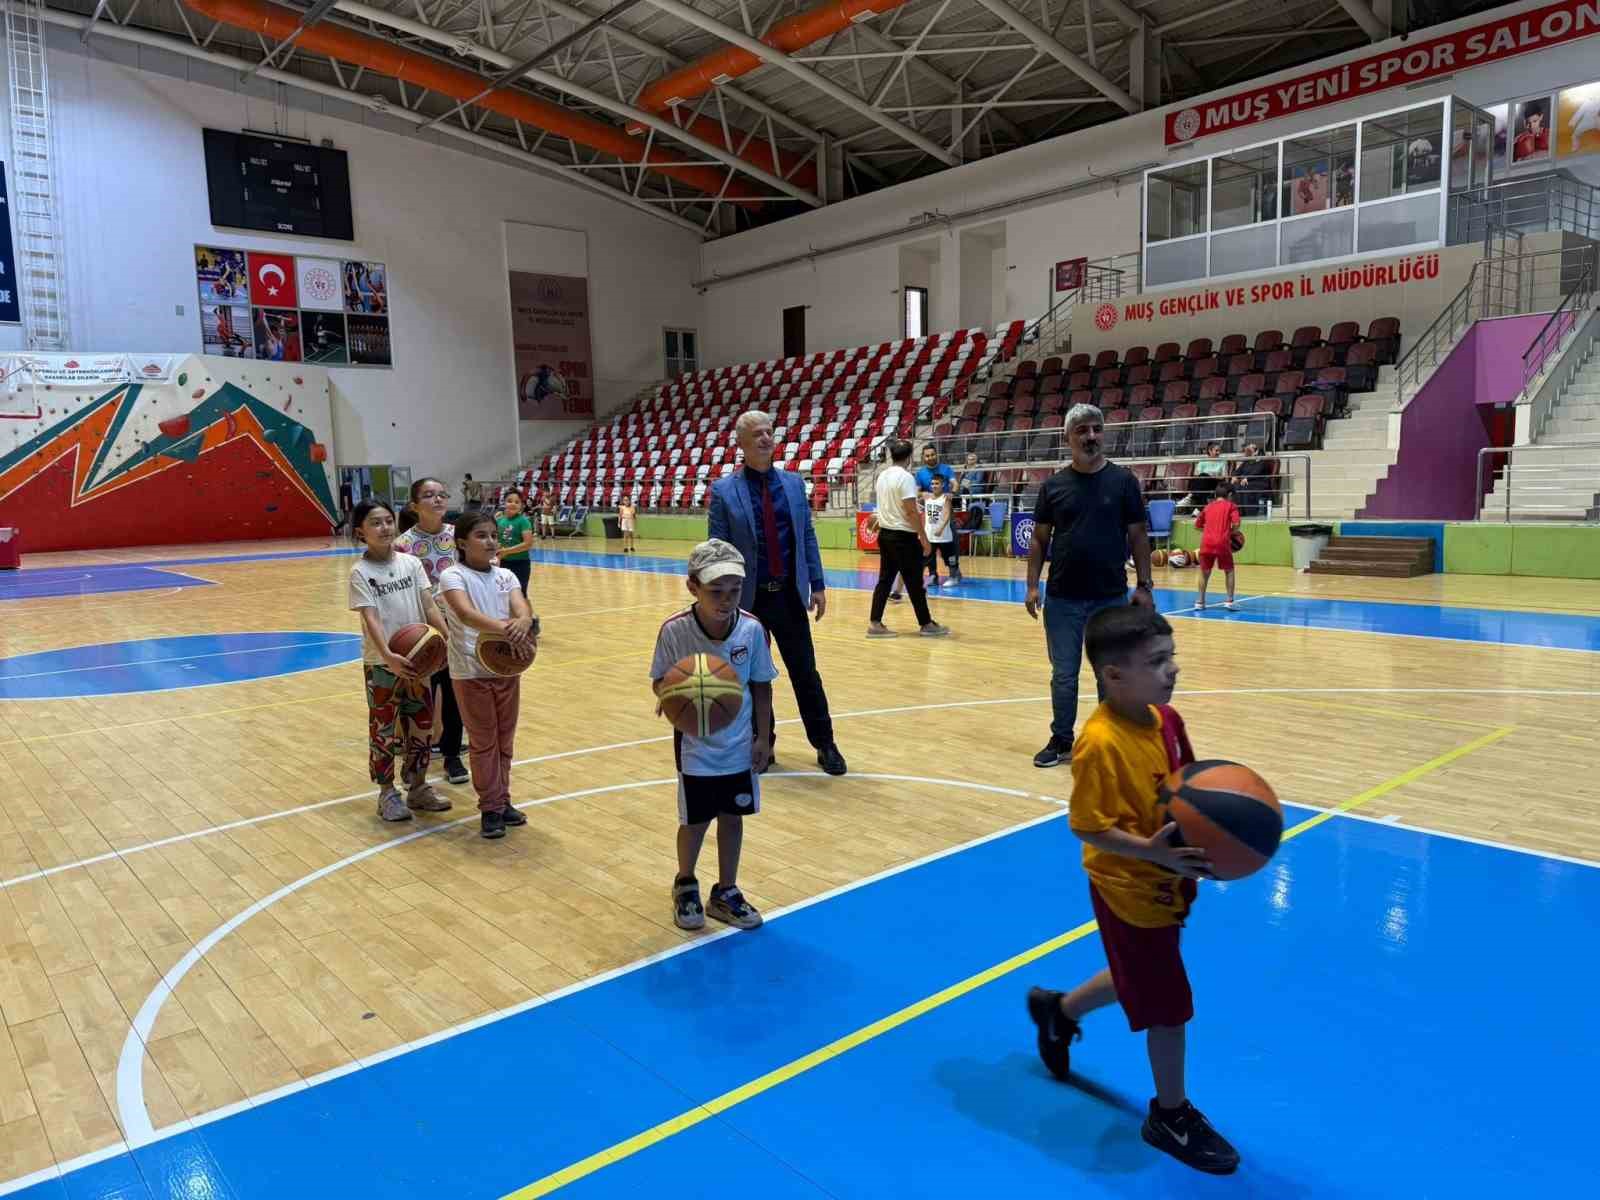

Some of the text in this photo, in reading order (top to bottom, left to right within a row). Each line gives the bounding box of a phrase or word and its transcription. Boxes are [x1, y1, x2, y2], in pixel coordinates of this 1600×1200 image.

[1205, 96, 1270, 129] MUŞ
[1277, 65, 1352, 109] YENİ
[1360, 43, 1455, 89] SPOR
[1124, 254, 1440, 322] MUŞ GENÇLİK VE SPOR İL MÜDÜRLÜĞÜ
